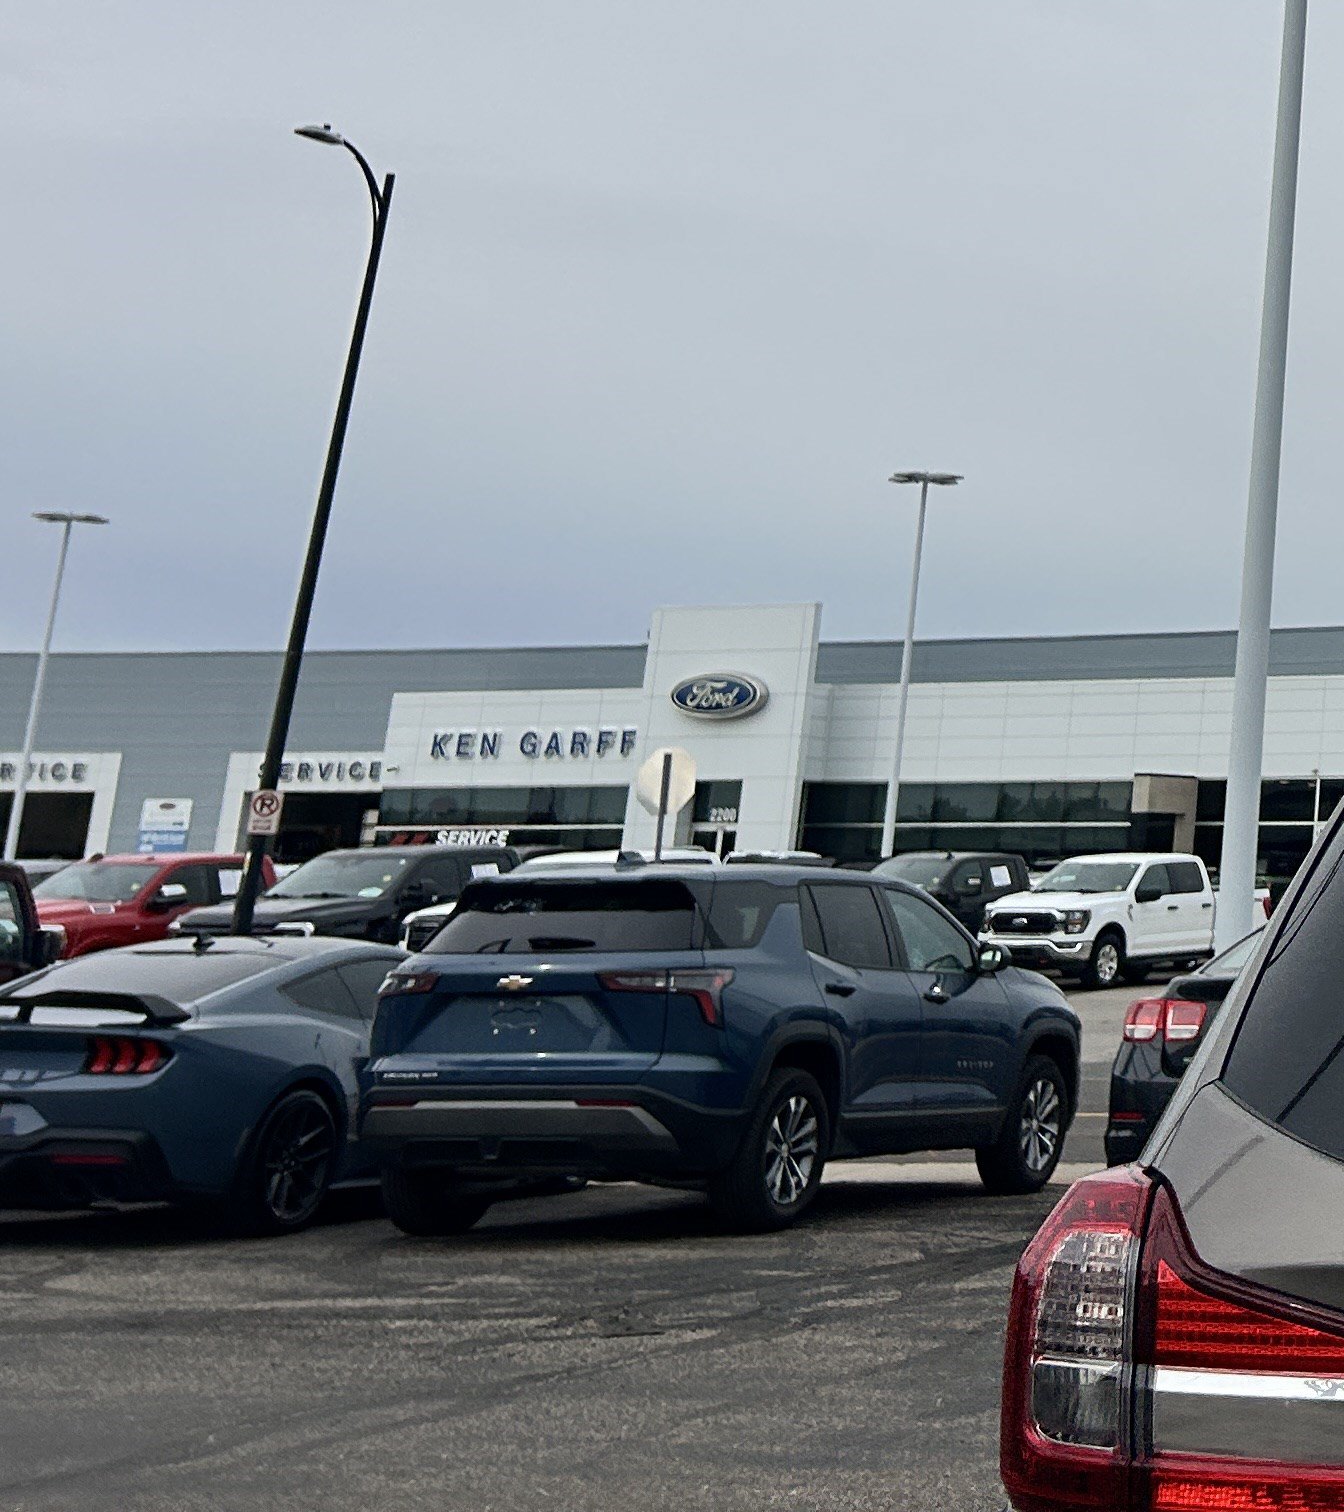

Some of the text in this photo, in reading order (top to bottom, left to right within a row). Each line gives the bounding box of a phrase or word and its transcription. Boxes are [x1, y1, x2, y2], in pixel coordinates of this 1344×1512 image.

[686, 681, 740, 708] Ford
[430, 730, 638, 758] KEN GARFF
[435, 830, 510, 848] SERVICE
